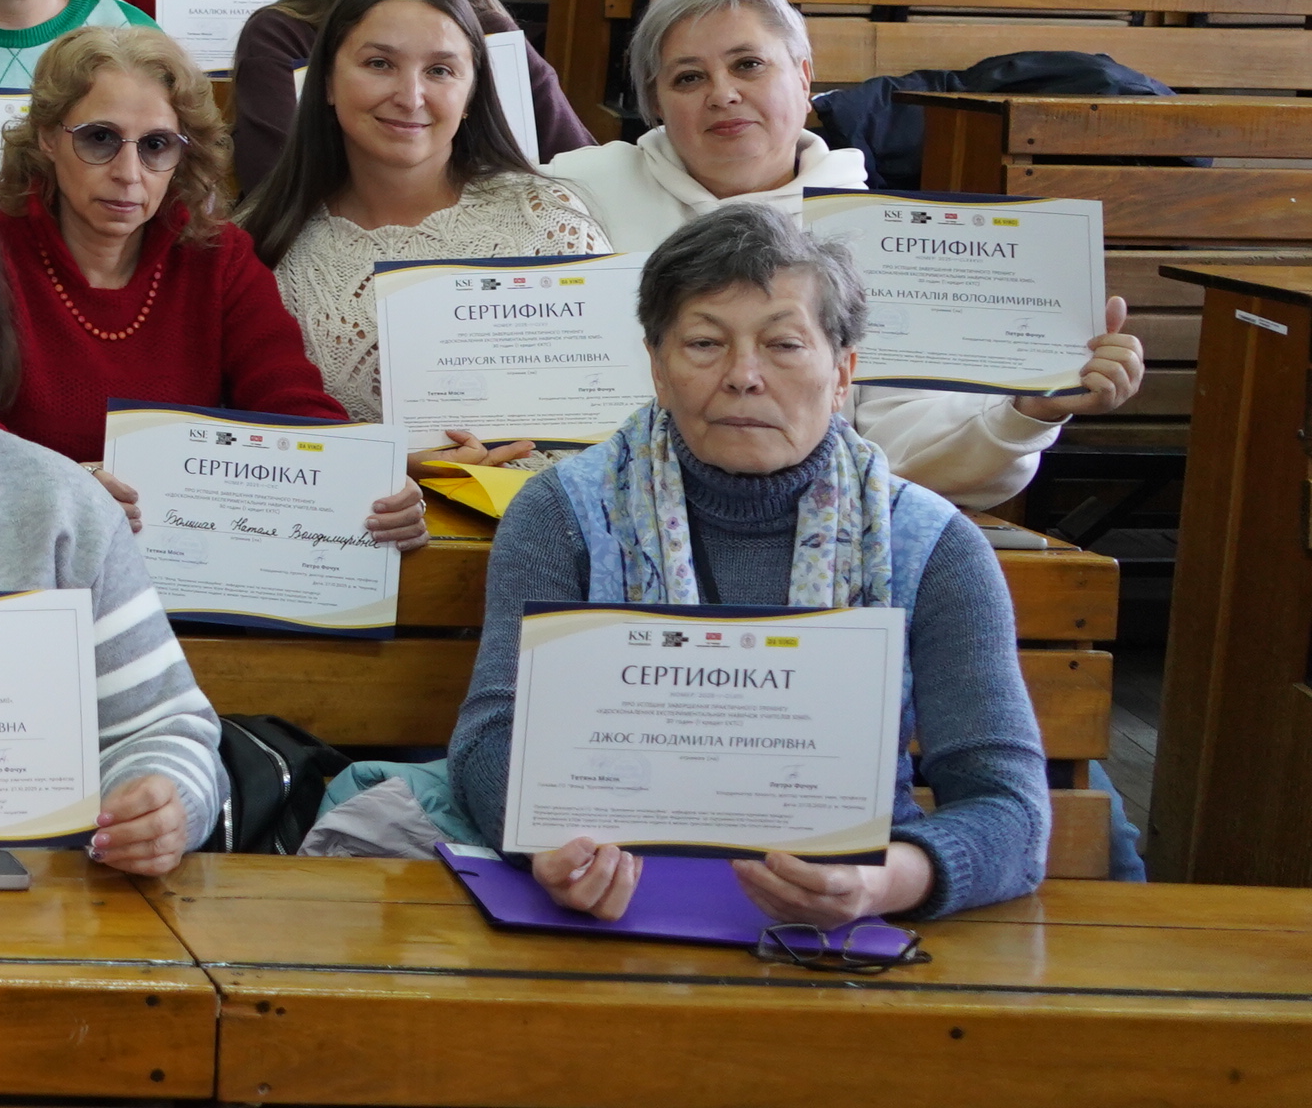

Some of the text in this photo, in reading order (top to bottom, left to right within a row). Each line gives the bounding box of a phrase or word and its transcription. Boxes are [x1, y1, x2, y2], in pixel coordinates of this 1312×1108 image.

[884, 210, 903, 220] KSE
[881, 236, 1019, 260] СЕРТИФІКАТ
[455, 279, 473, 288] KSE
[897, 290, 948, 301] НАТАЛІЯ
[952, 292, 1061, 308] ВОЛОДИМИРІВНА
[454, 301, 585, 321] СЕРТИФІКАТ
[437, 352, 610, 367] АНДРУСЯК ТЕТЯНА ВАСИЛІВНА
[190, 429, 208, 439] KSE
[184, 457, 321, 486] СЕРТИФІКАТ
[629, 631, 652, 643] KSE
[622, 665, 795, 690] СЕРТИФІКАТ
[589, 731, 816, 750] ДЖОС ЛЮДМИЛА ГРИГОРІВНА
[4, 766, 27, 774] Фочук
